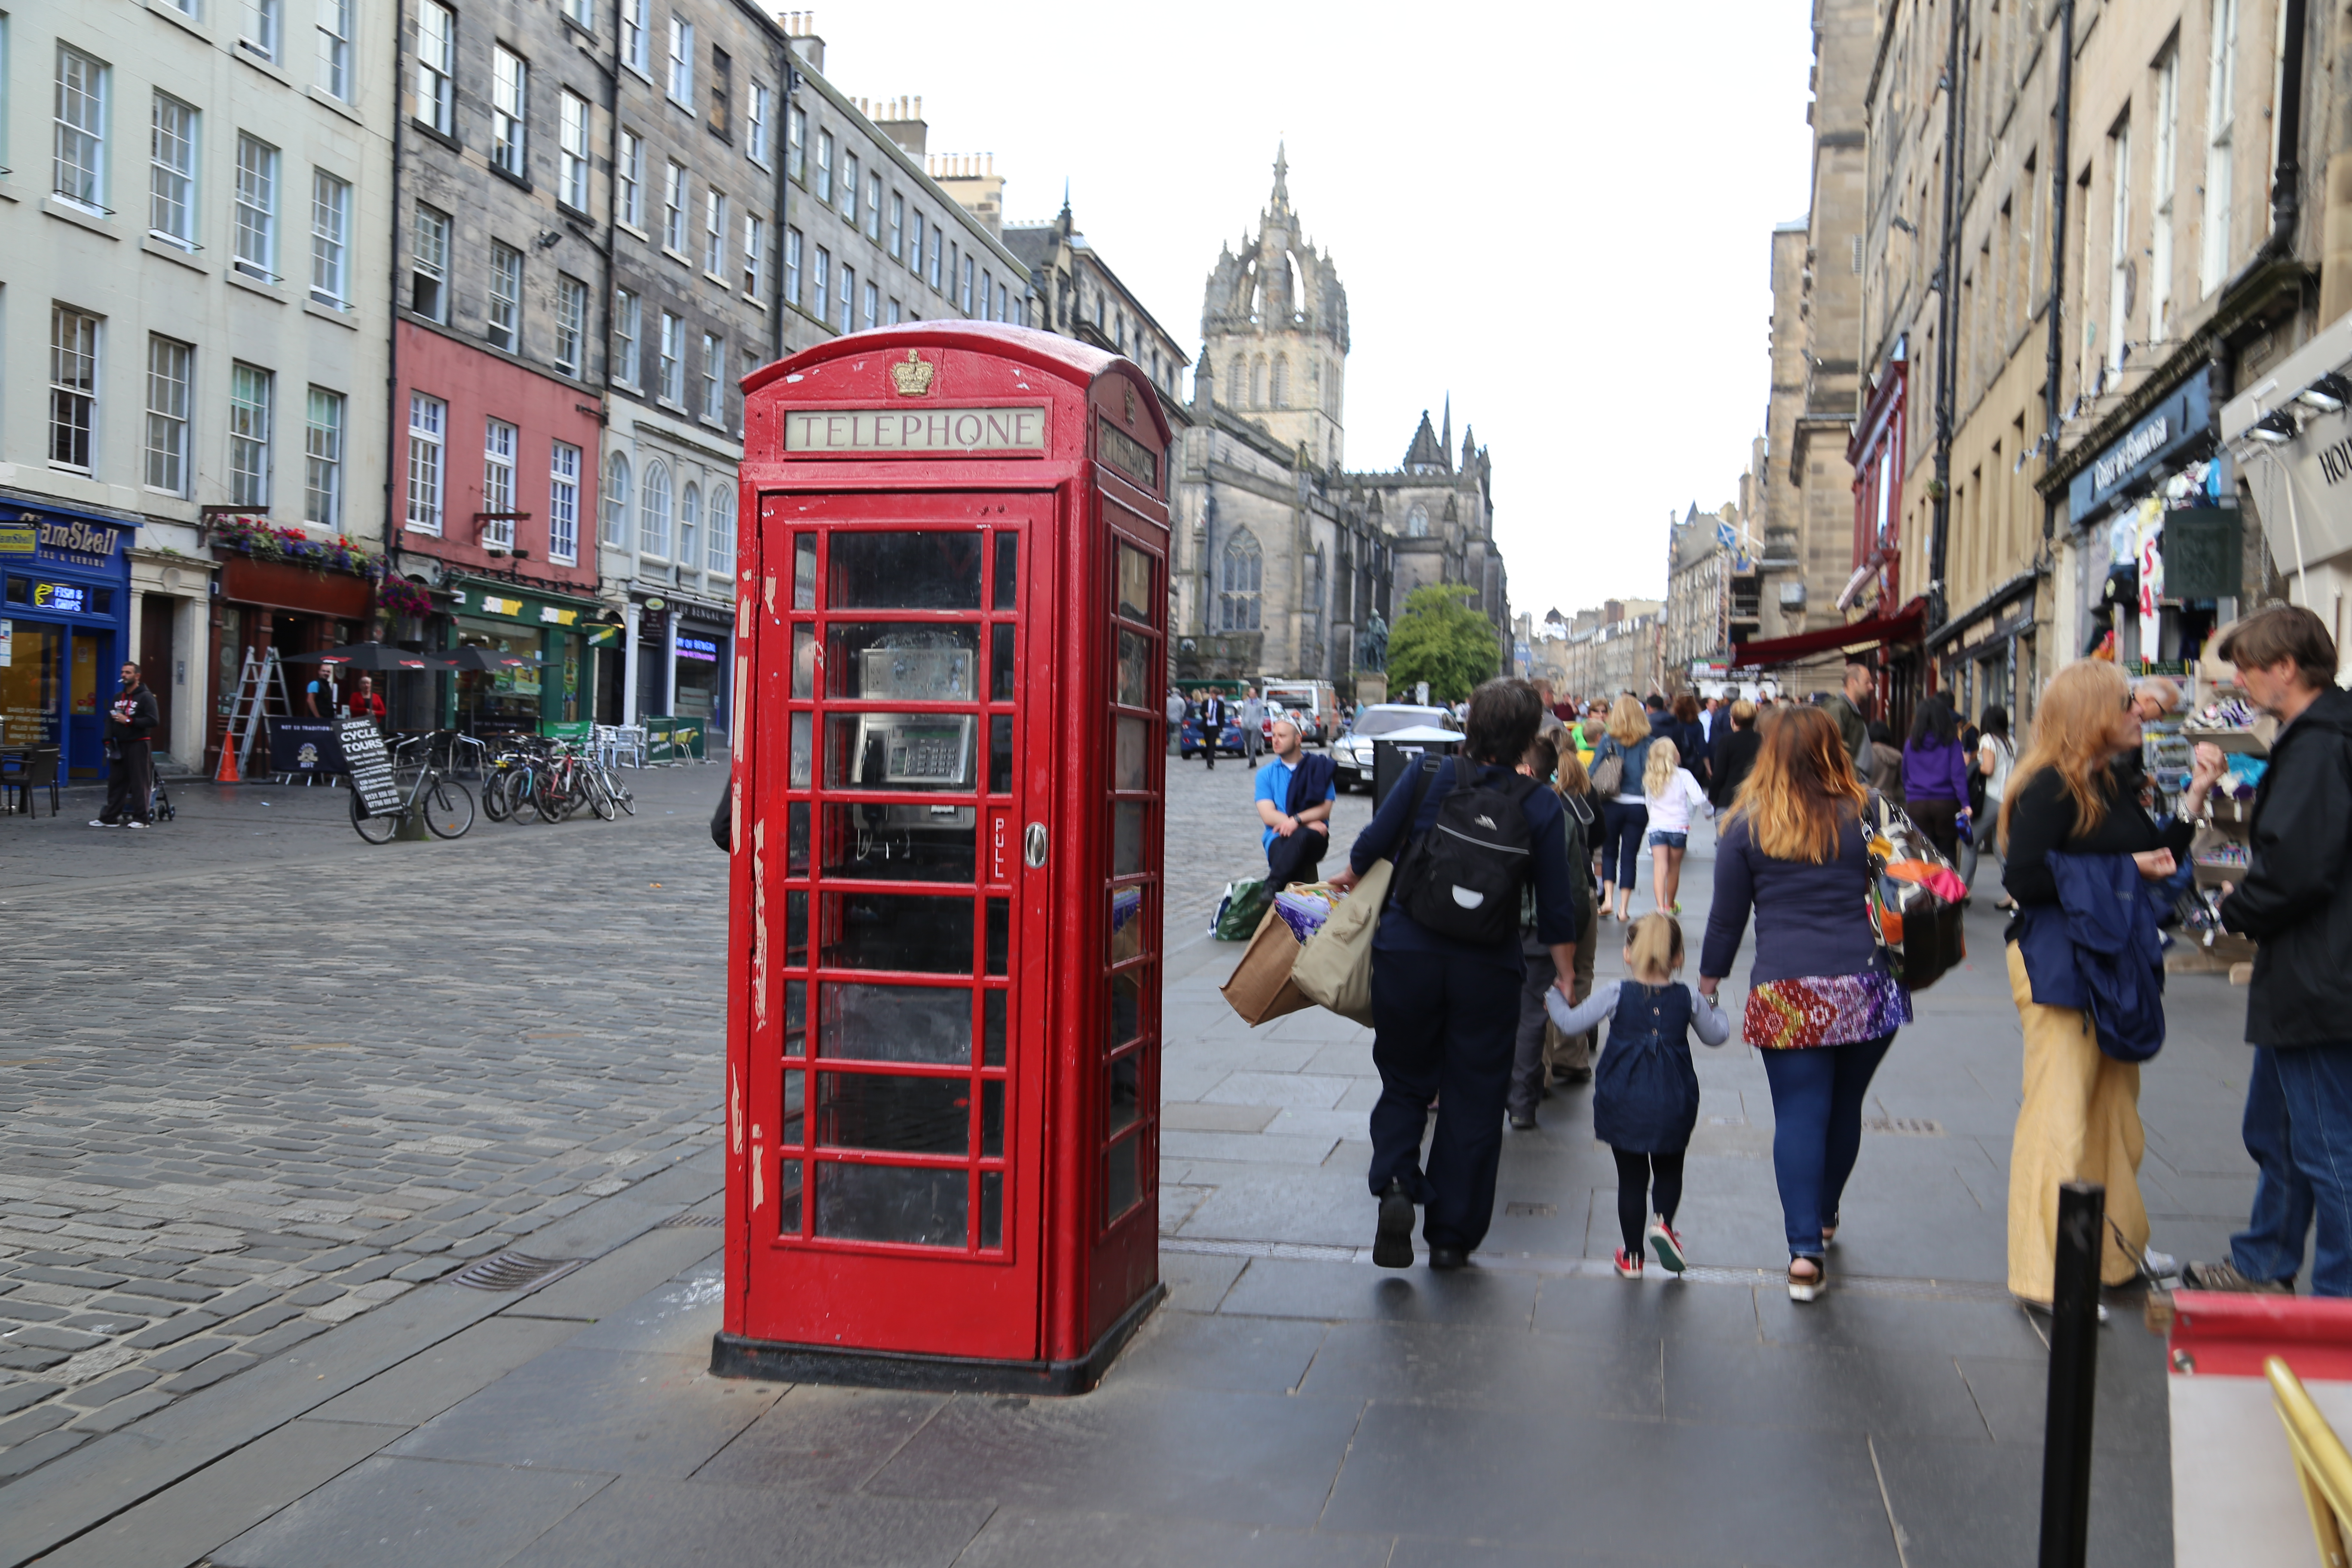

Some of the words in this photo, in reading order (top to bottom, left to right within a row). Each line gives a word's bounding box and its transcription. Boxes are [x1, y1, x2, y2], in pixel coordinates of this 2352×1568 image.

[798, 413, 1035, 448] TELEPHONE
[341, 720, 371, 730] SCENIC
[340, 727, 380, 742] CYCLE
[342, 738, 385, 753] TOURS
[995, 818, 1004, 878] PULL
